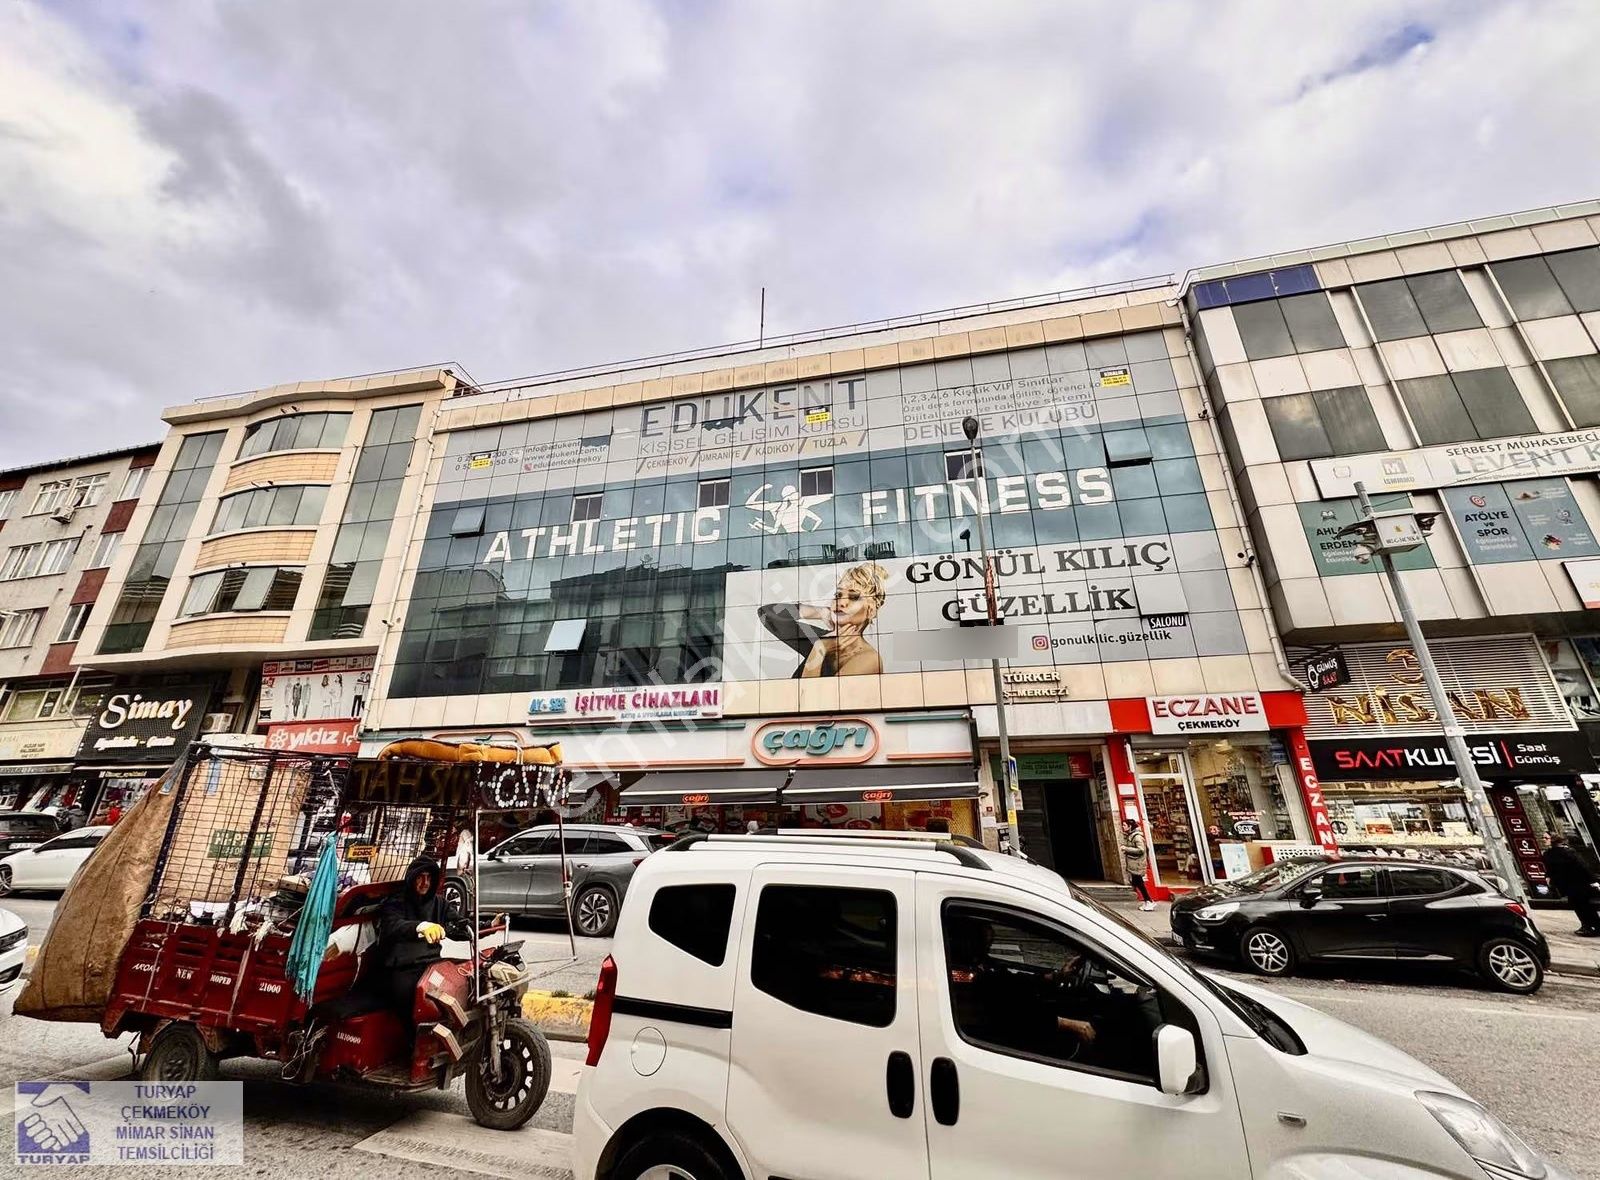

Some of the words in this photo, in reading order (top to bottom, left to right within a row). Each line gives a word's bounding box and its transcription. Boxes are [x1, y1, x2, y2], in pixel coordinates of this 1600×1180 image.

[993, 382, 1012, 392] VIP
[641, 378, 865, 438] EDUKENT
[904, 416, 994, 442] DENEE
[813, 437, 848, 449] TUZLA
[1446, 442, 1502, 457] SERBEST
[1450, 448, 1573, 476] LEVENT
[862, 466, 1115, 528] FITNESS
[1465, 510, 1509, 523] ATÖLYE
[482, 507, 721, 565] ATHLETIC
[1477, 527, 1509, 538] SPOR
[906, 549, 1045, 584] GÖNÜL
[1053, 541, 1171, 572] KILIÇ
[941, 584, 1136, 622] GÜZELLİK
[1150, 615, 1185, 629] SALONU
[1051, 629, 1172, 649] gonulkilic.güzellik
[1003, 671, 1060, 684] TÜRKER
[1017, 686, 1069, 697] MERKEZİ
[575, 691, 627, 716] İŞİTME
[632, 688, 718, 710] CİHAZLARI
[1152, 694, 1260, 718] ECZANE
[100, 692, 192, 731] Simay
[1177, 718, 1241, 732] ÇEKMEKÖY
[763, 720, 869, 755] çağrı
[1516, 743, 1548, 753] Saat
[1514, 753, 1561, 765] Gümüş
[175, 968, 194, 981] NEW
[258, 982, 282, 994] 21000
